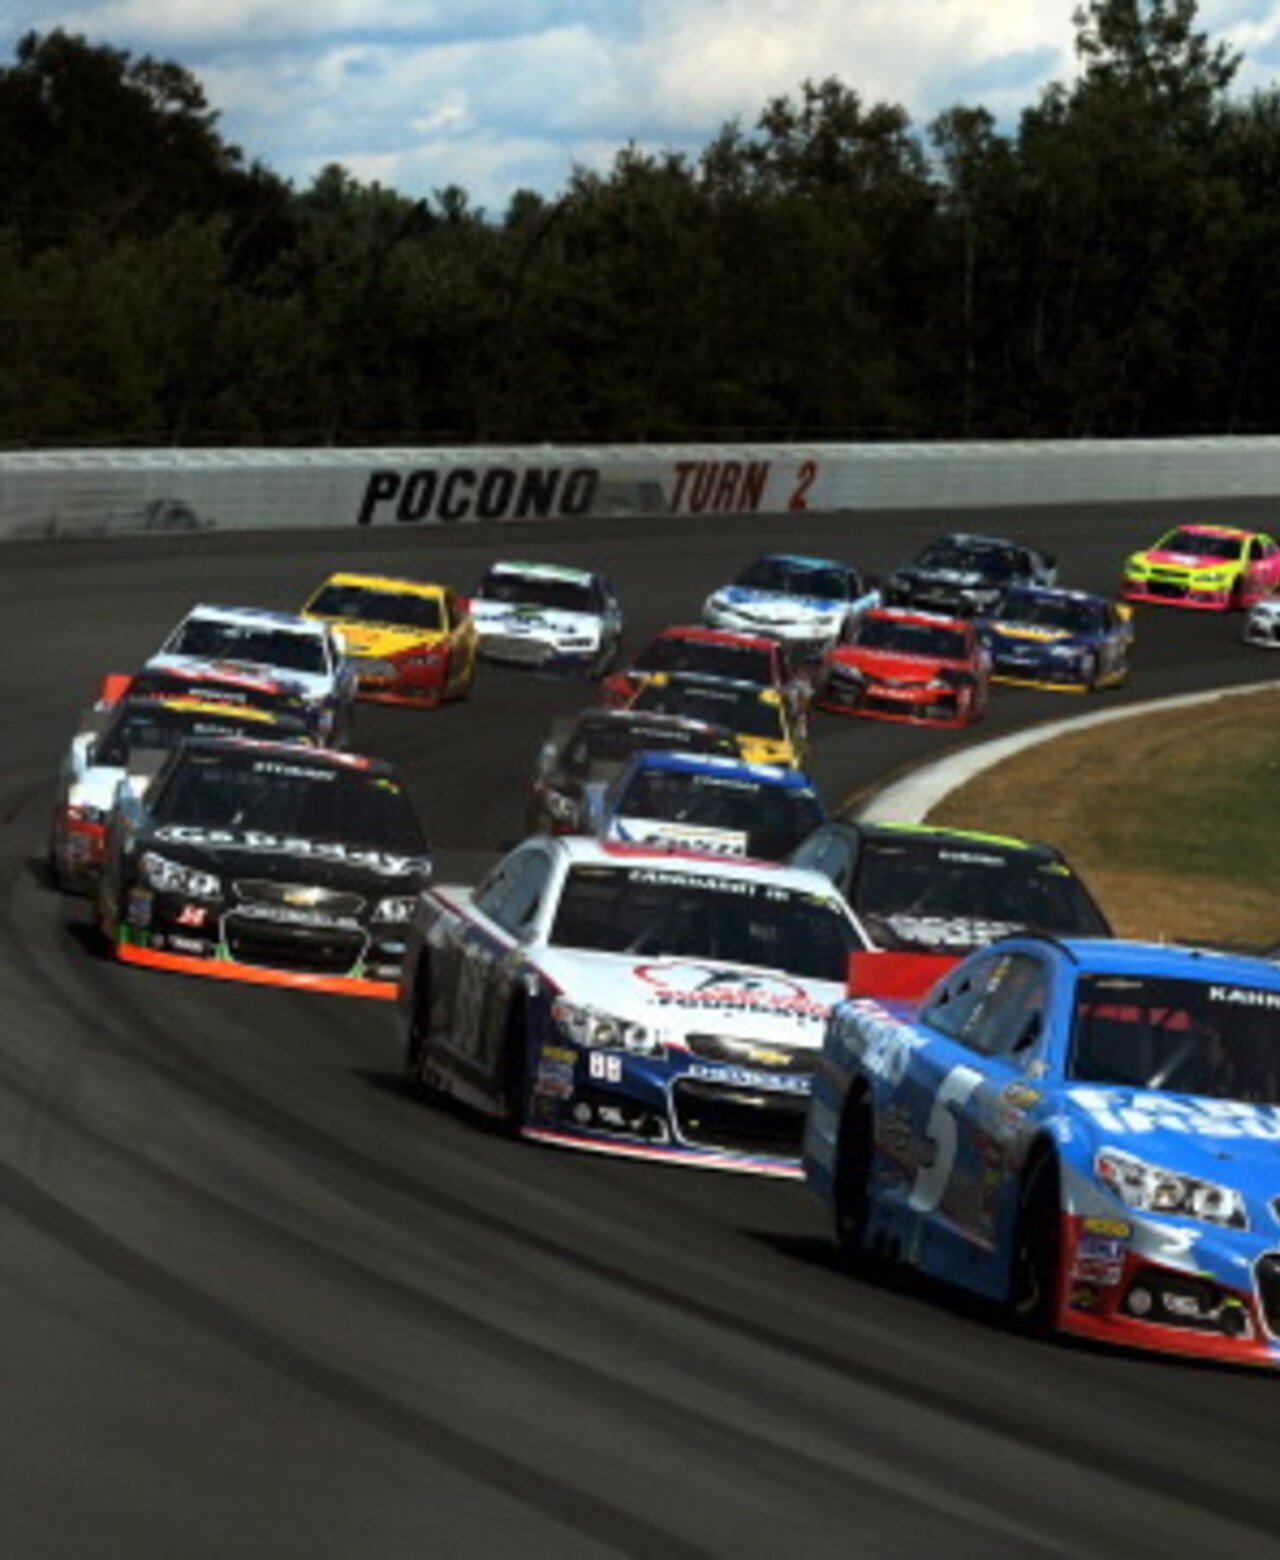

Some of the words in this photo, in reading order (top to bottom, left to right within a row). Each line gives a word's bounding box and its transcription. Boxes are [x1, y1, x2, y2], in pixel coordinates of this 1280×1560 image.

[358, 467, 599, 524] POCONO
[669, 460, 771, 513] TURN
[787, 461, 817, 511] 2
[589, 1051, 622, 1083] 88
[907, 1063, 986, 1212] 5
